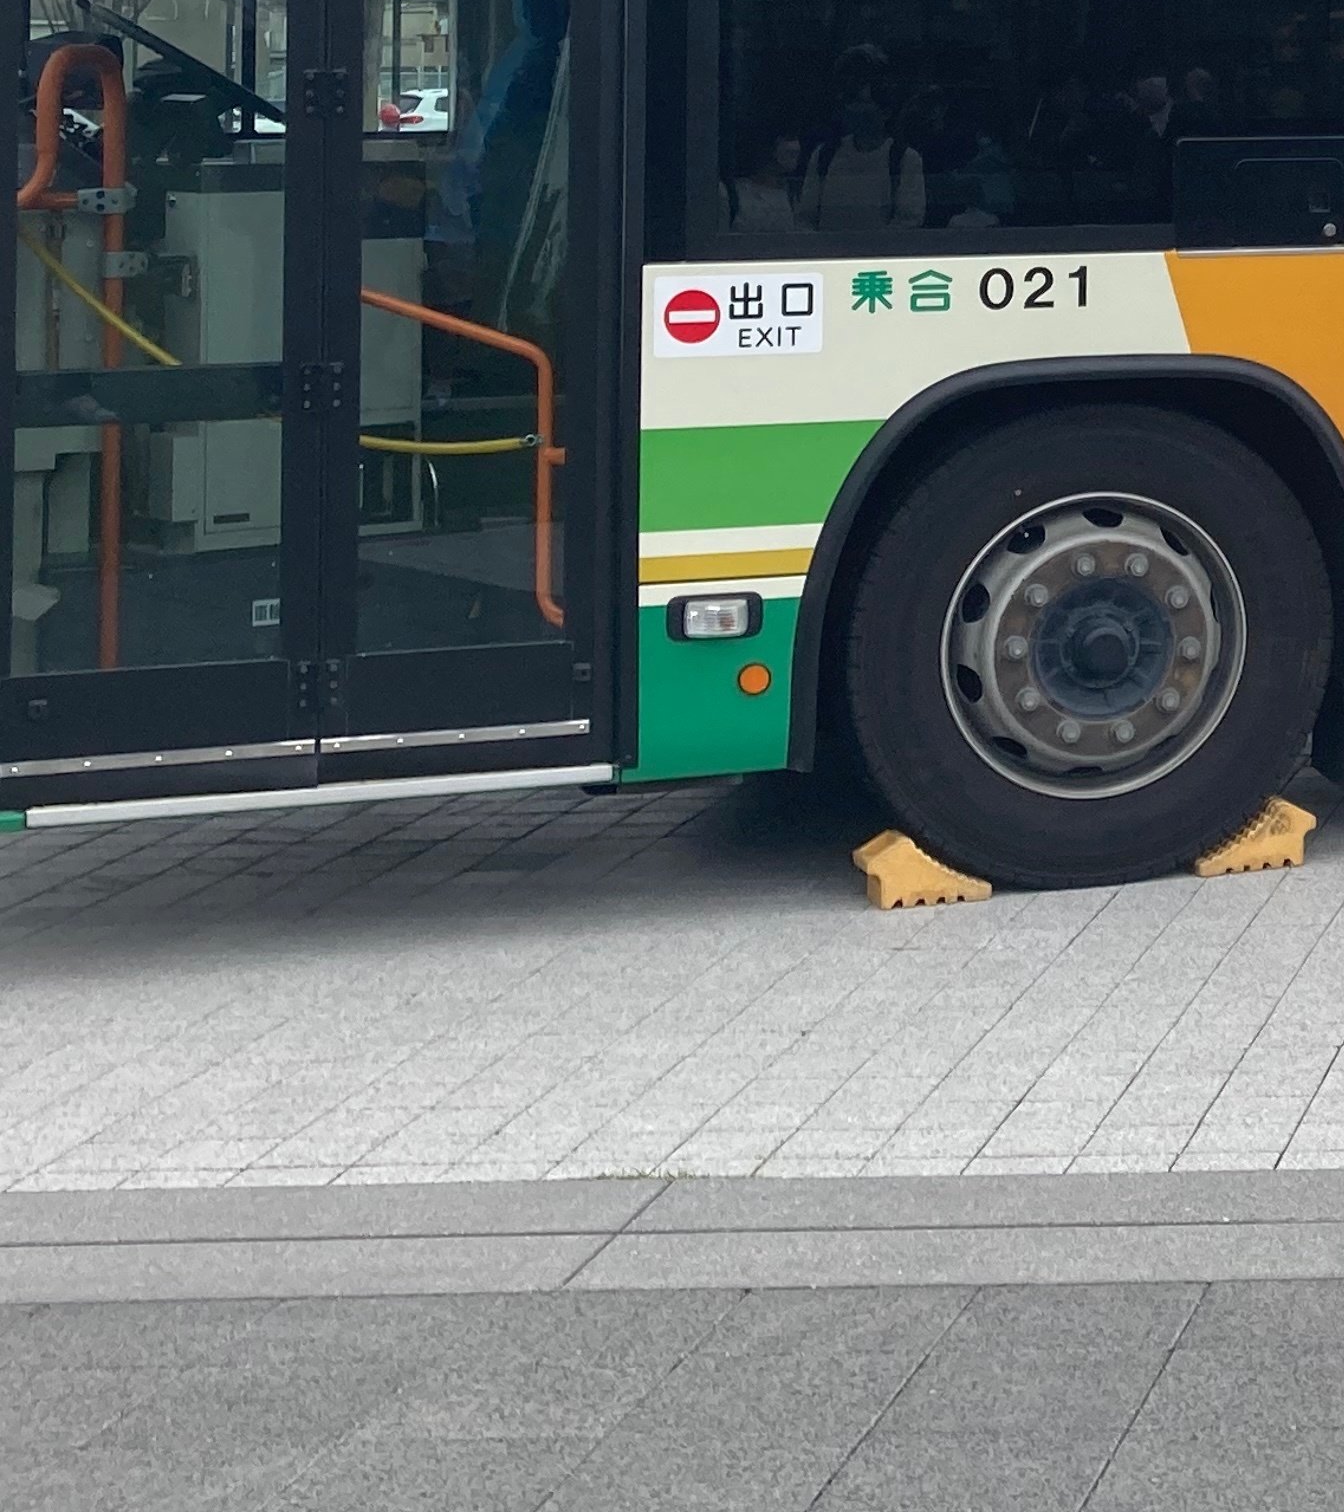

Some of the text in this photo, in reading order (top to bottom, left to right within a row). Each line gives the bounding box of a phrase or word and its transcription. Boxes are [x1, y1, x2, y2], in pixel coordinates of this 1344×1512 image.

[729, 282, 815, 320] 出口
[851, 264, 1089, 314] 乗合 021
[738, 326, 803, 348] EXIT
